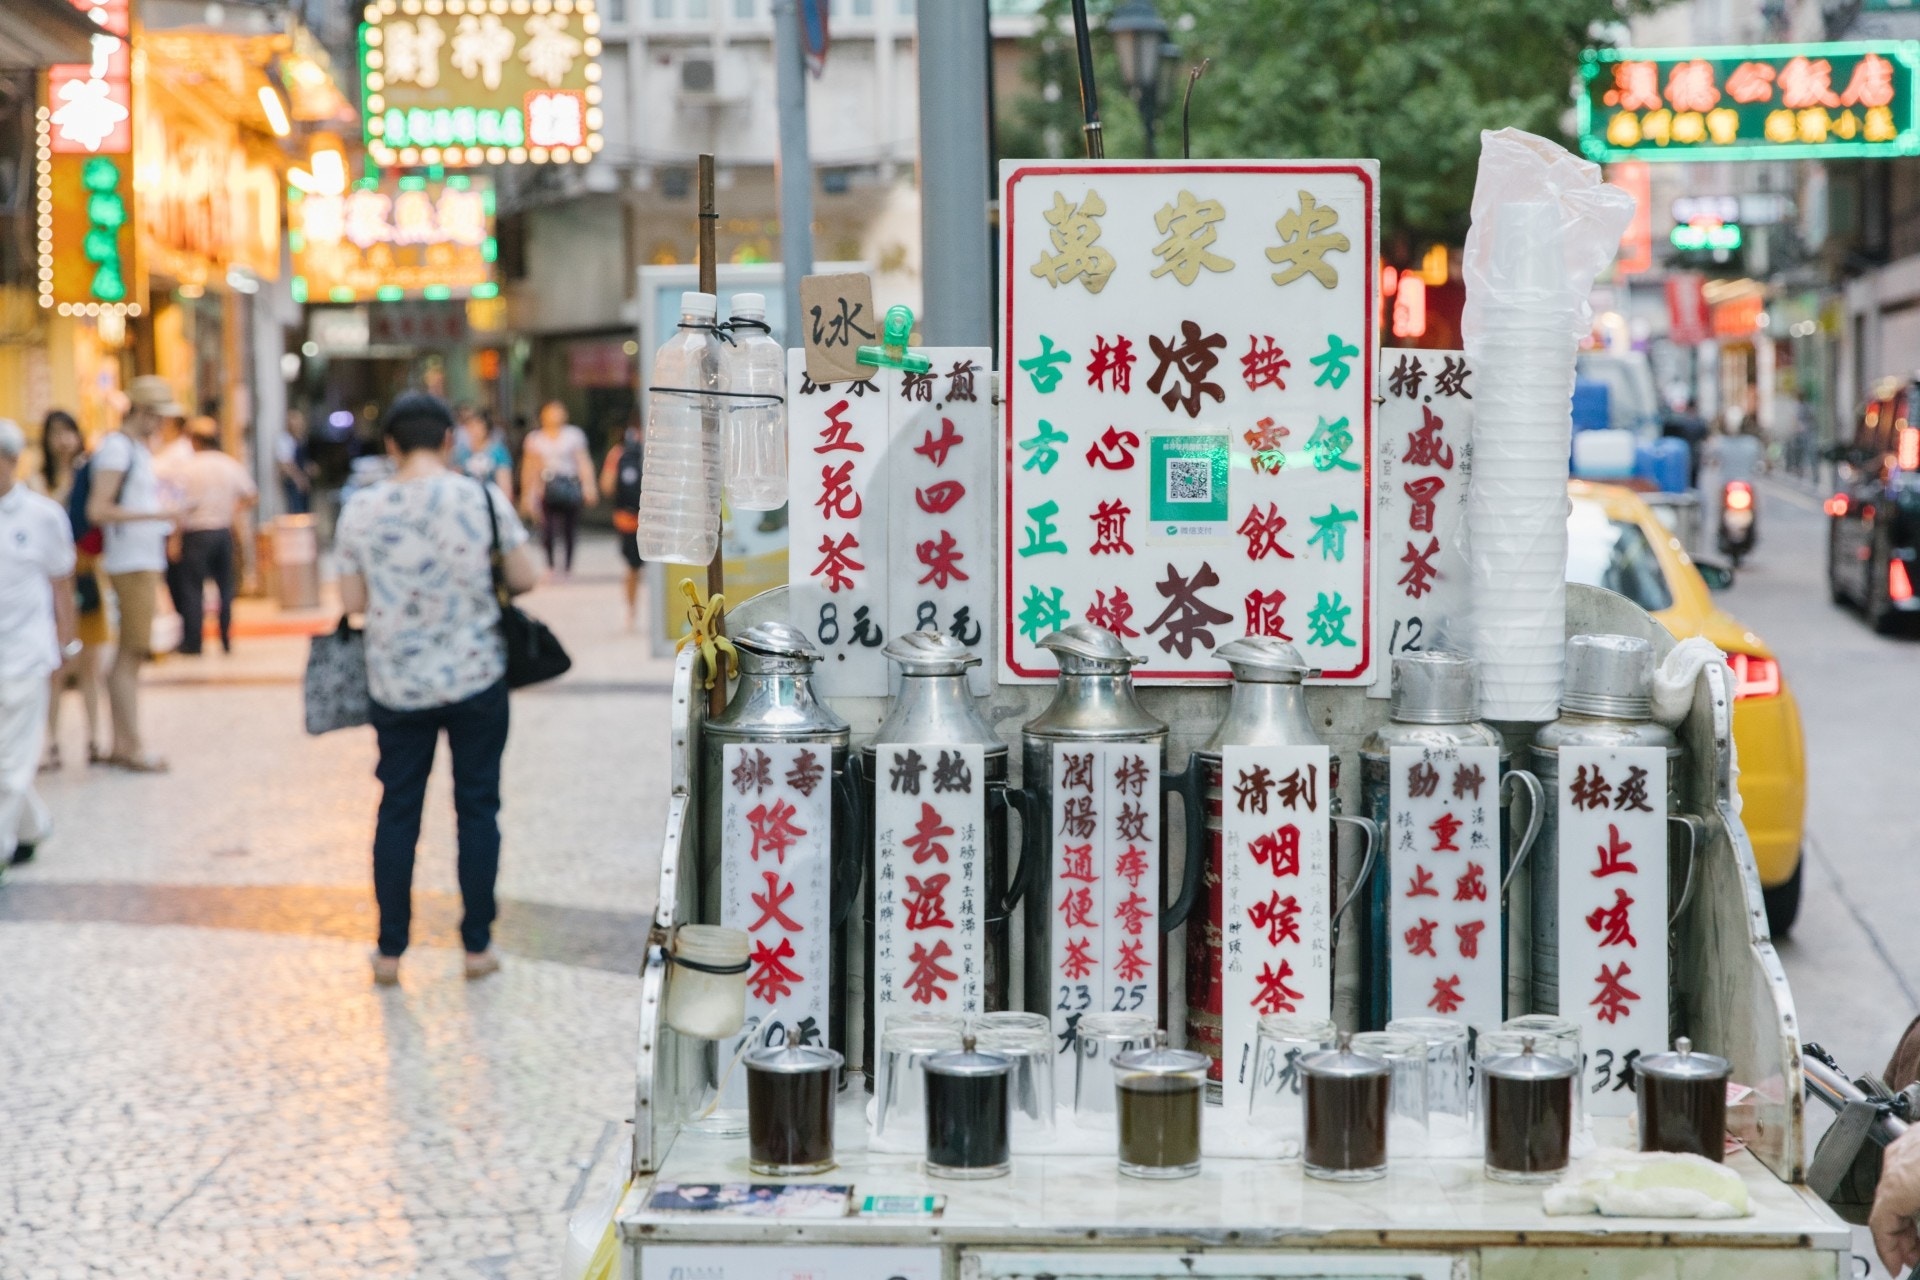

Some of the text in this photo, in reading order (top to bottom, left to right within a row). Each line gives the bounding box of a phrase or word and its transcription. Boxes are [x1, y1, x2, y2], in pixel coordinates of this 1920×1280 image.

[810, 297, 875, 348] 冰
[1030, 188, 1351, 294] 萬家安
[1388, 354, 1473, 400] 特效
[811, 399, 865, 593] 五花茶
[913, 417, 969, 590] 廿四味
[1017, 335, 1072, 643] 古方正料
[1236, 334, 1295, 642] 按需飲服
[1307, 334, 1361, 648] 方便有效
[1397, 404, 1454, 600] 感冒茶
[818, 602, 884, 647] 8元
[888, 748, 972, 796] 清熱
[1232, 763, 1318, 816] 清利
[1428, 812, 1464, 852] 重
[745, 797, 807, 1005] 降火茶
[1058, 752, 1100, 981] 潤腸通便茶
[1113, 754, 1153, 983] 特效痔瘡茶
[1248, 822, 1305, 1016] 咽喉茶
[1585, 823, 1641, 1025] 止咳茶
[1057, 984, 1092, 1011] 23
[1111, 984, 1147, 1011] 25
[1427, 973, 1465, 1013] 茶
